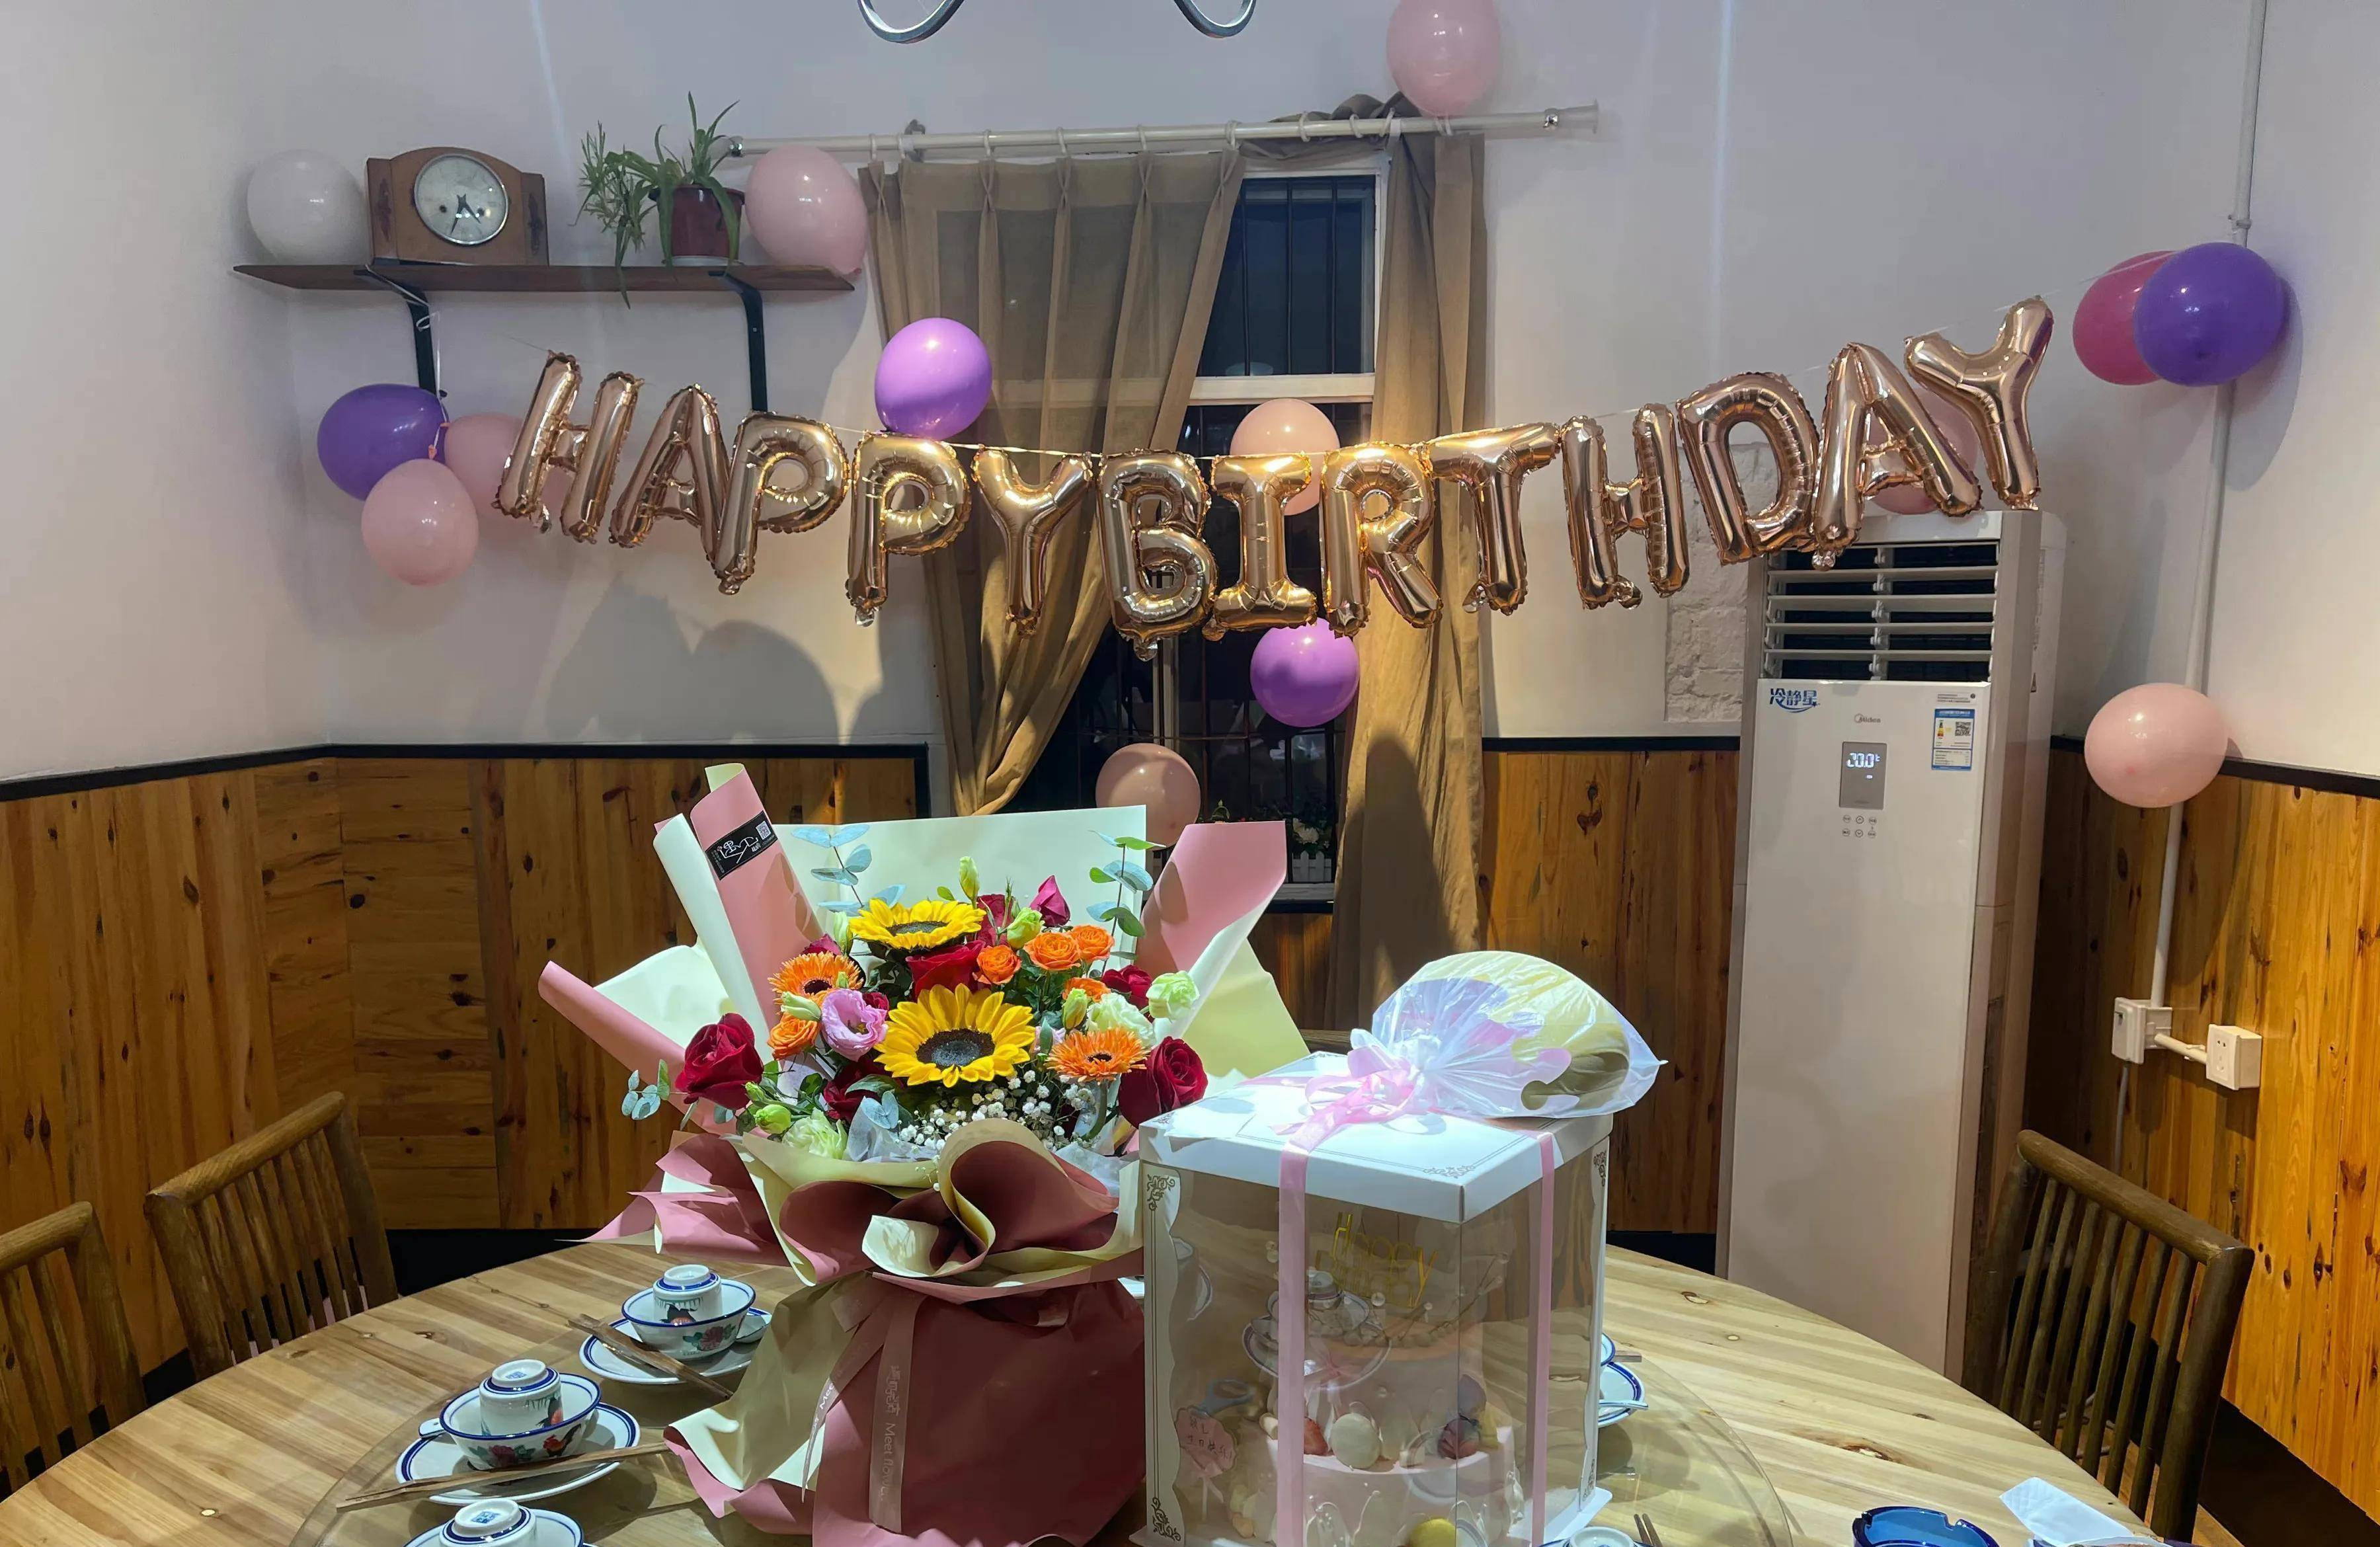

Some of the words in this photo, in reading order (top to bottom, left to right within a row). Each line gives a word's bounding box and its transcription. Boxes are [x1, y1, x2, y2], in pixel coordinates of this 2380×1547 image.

[495, 350, 1094, 636] HAPPY
[1095, 296, 2053, 657] BIRTHDAY
[1770, 688, 1818, 706] 冷静星
[883, 1422, 895, 1454] Meet
